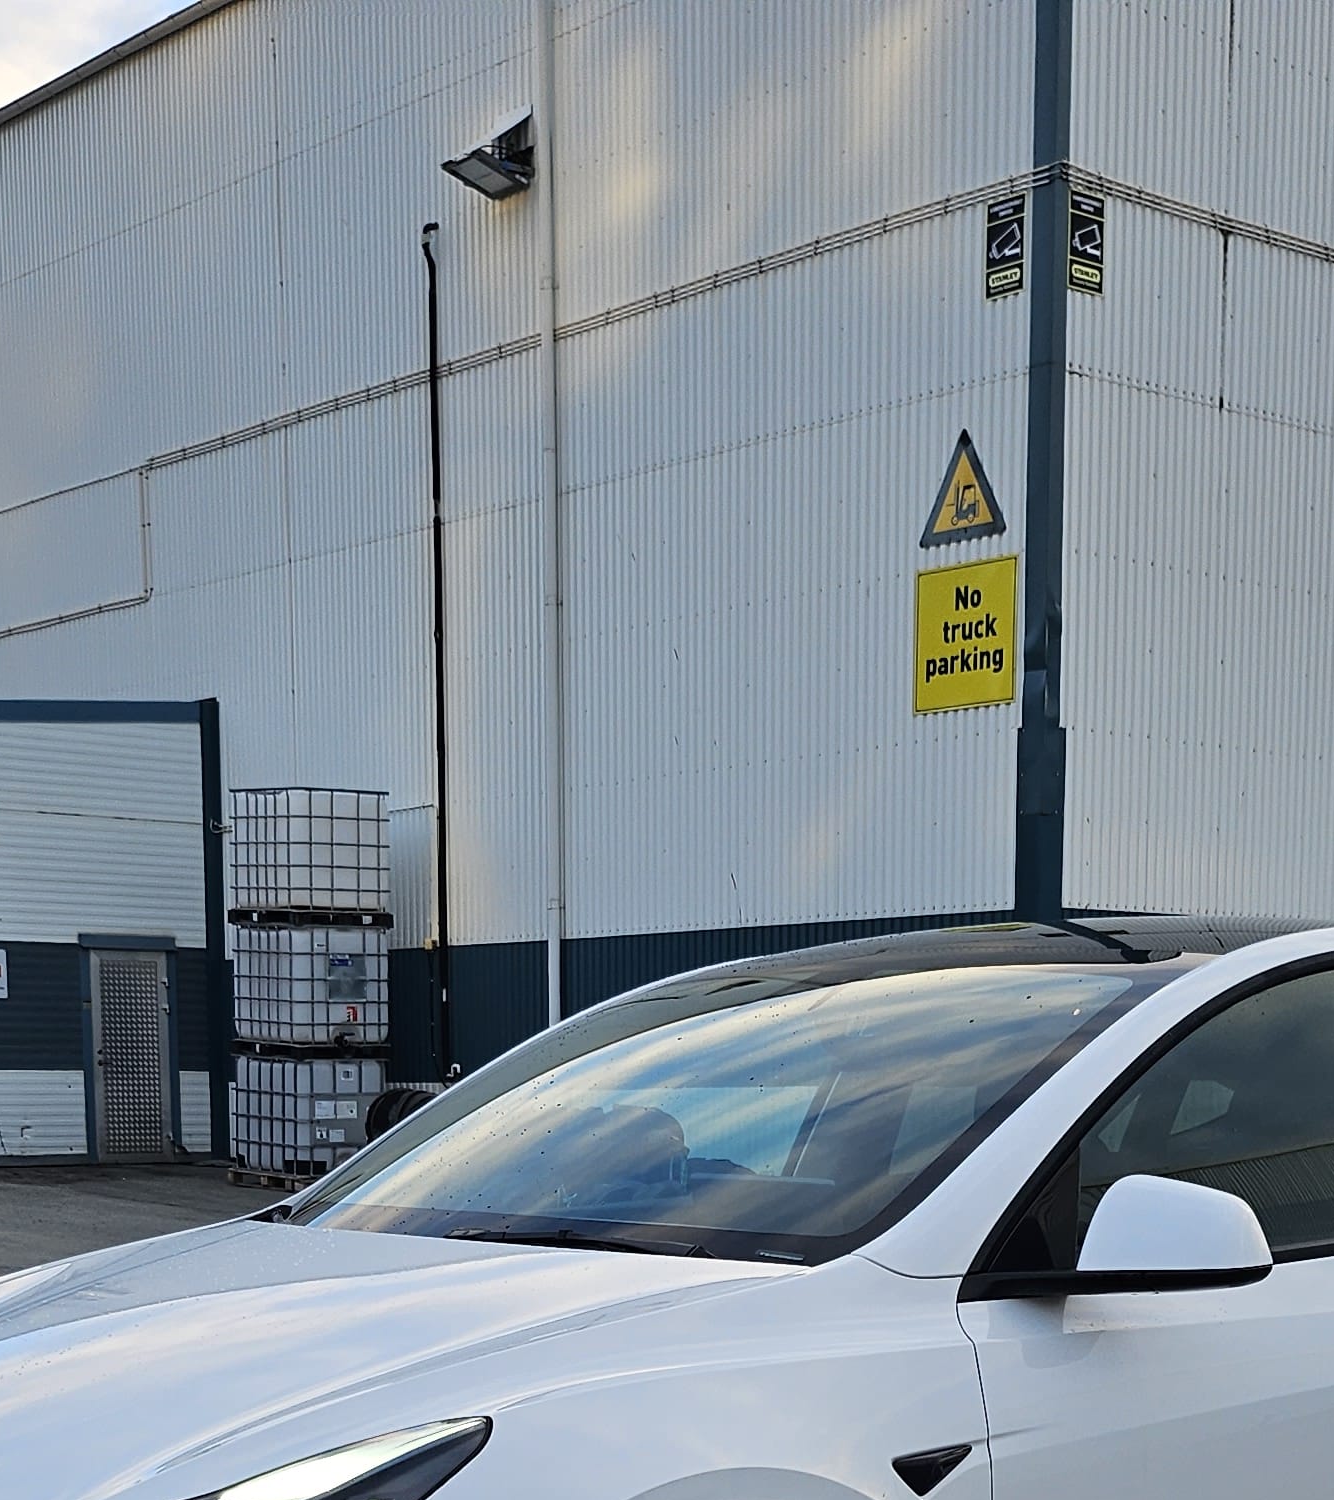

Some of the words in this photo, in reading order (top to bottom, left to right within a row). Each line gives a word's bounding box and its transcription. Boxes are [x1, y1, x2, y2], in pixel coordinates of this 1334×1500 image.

[955, 585, 982, 611] No
[943, 613, 997, 643] truck
[925, 646, 1004, 683] parking
